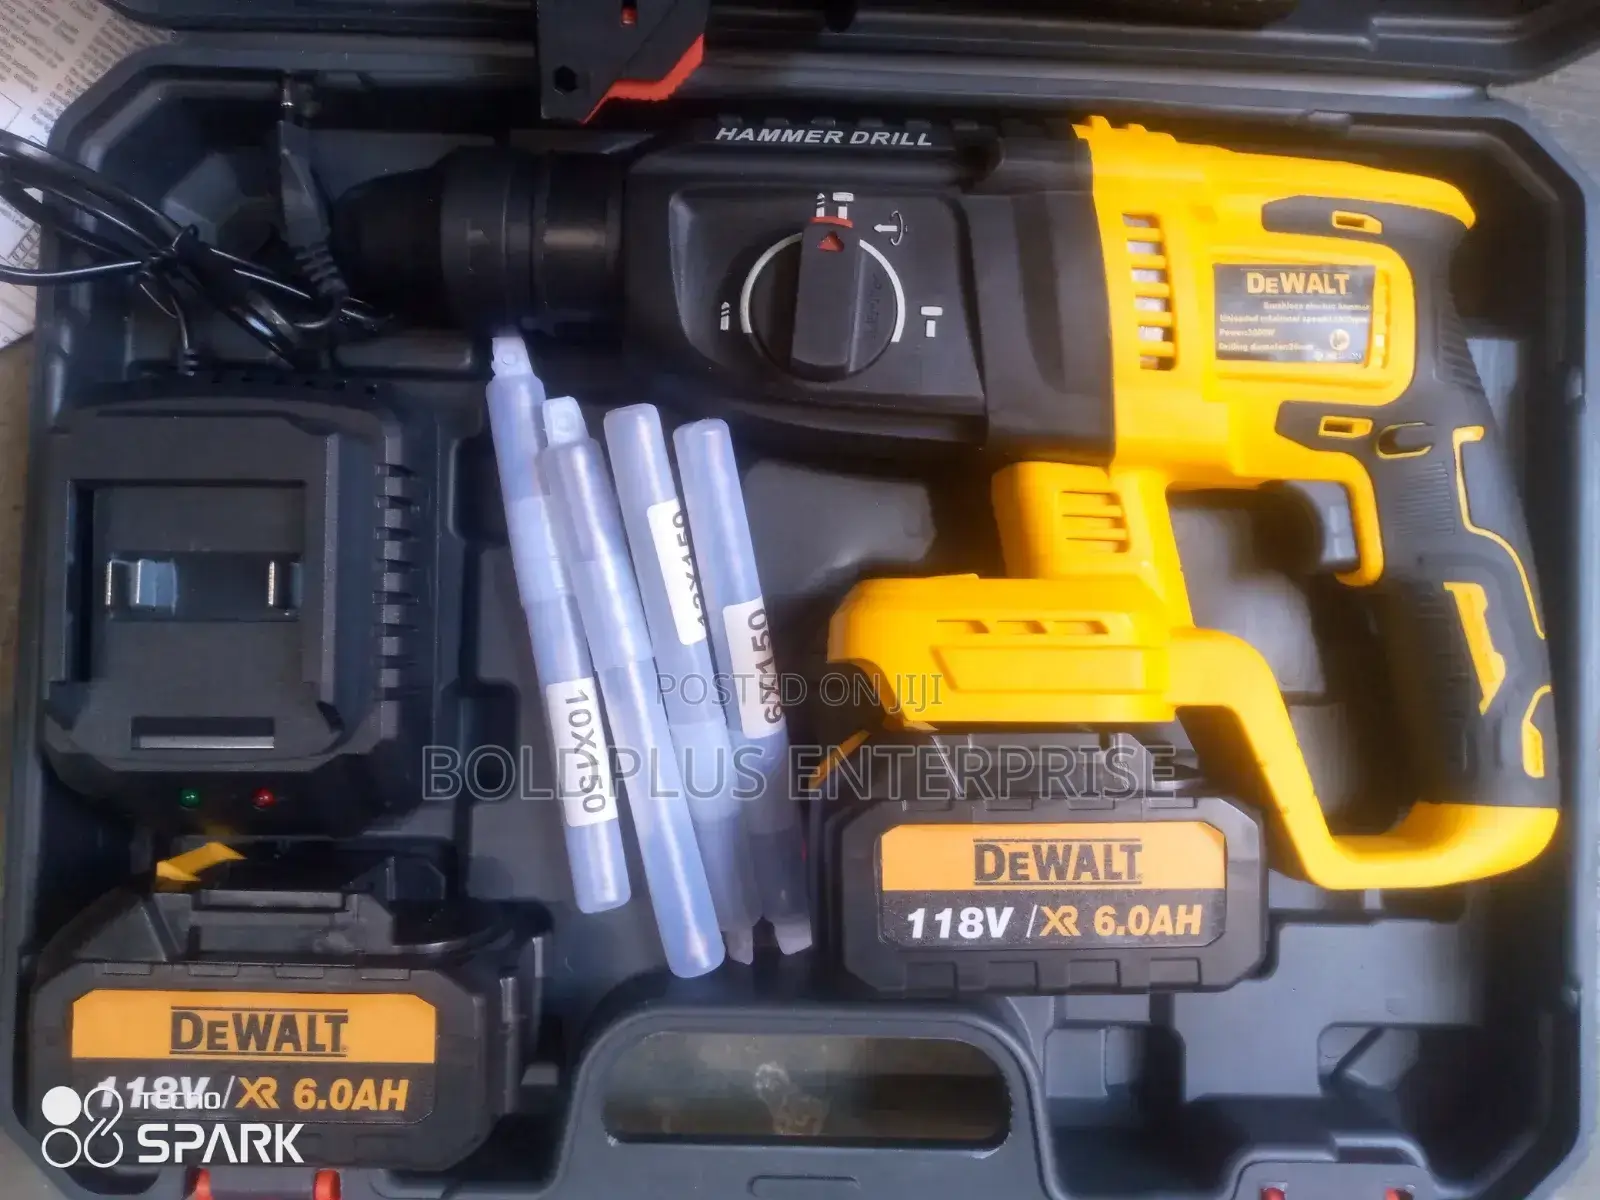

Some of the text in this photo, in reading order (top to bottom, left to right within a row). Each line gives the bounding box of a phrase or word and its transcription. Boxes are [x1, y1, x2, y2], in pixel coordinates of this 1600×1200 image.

[715, 127, 932, 146] HAMMER DRILL
[564, 688, 606, 814] 10X150
[907, 907, 1014, 938] 118V
[1093, 904, 1202, 936] 6.0AH
[293, 1078, 409, 1112] 6.0AH
